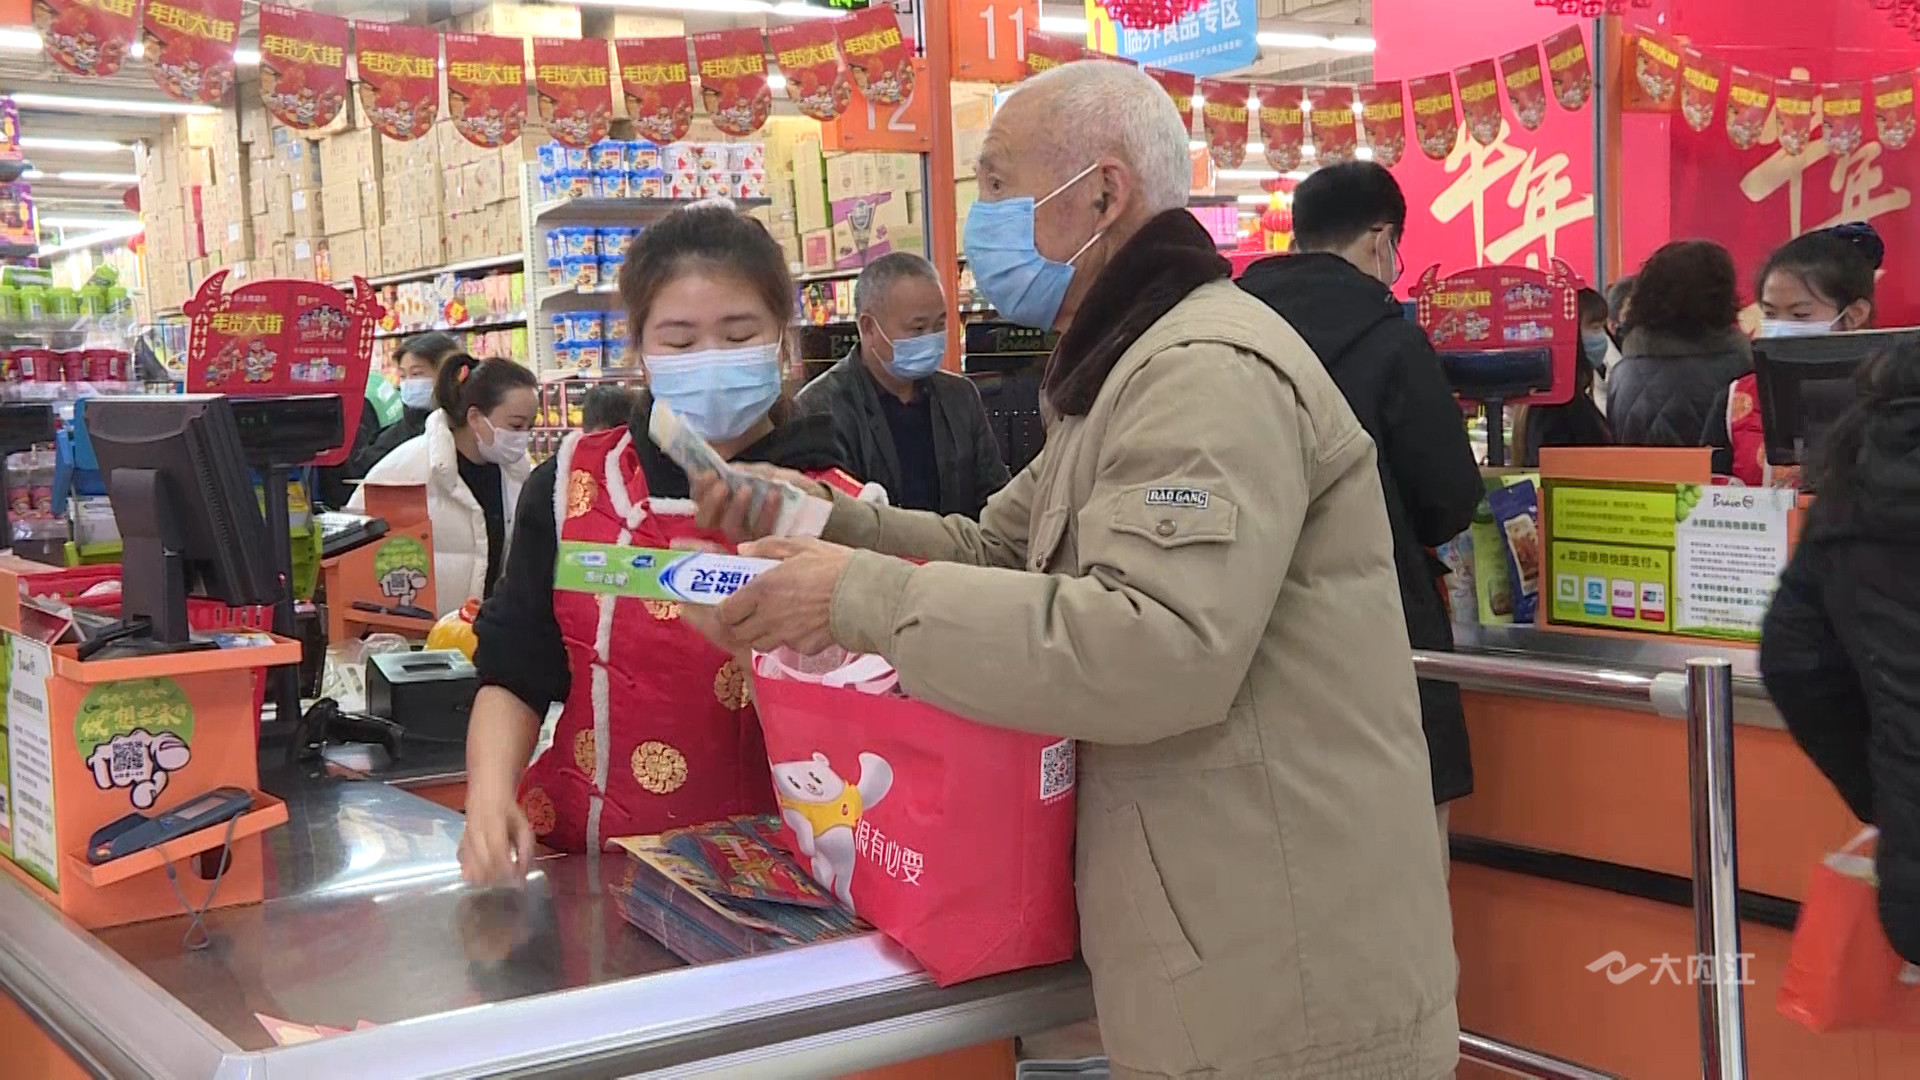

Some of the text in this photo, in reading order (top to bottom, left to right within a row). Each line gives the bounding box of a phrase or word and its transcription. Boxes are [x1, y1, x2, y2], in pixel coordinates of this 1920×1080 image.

[147, 2, 236, 42] 年货大街
[979, 4, 1025, 61] 11
[263, 34, 343, 66] 年货大街
[361, 50, 435, 78] 年货大街
[450, 61, 522, 84] 年货大街
[538, 65, 607, 86] 年货大街
[624, 63, 687, 82] 年货大街
[701, 54, 763, 78] 年货大街
[1430, 117, 1594, 268] 牛年
[211, 312, 284, 335] 年货大街
[1176, 491, 1206, 504] GANG
